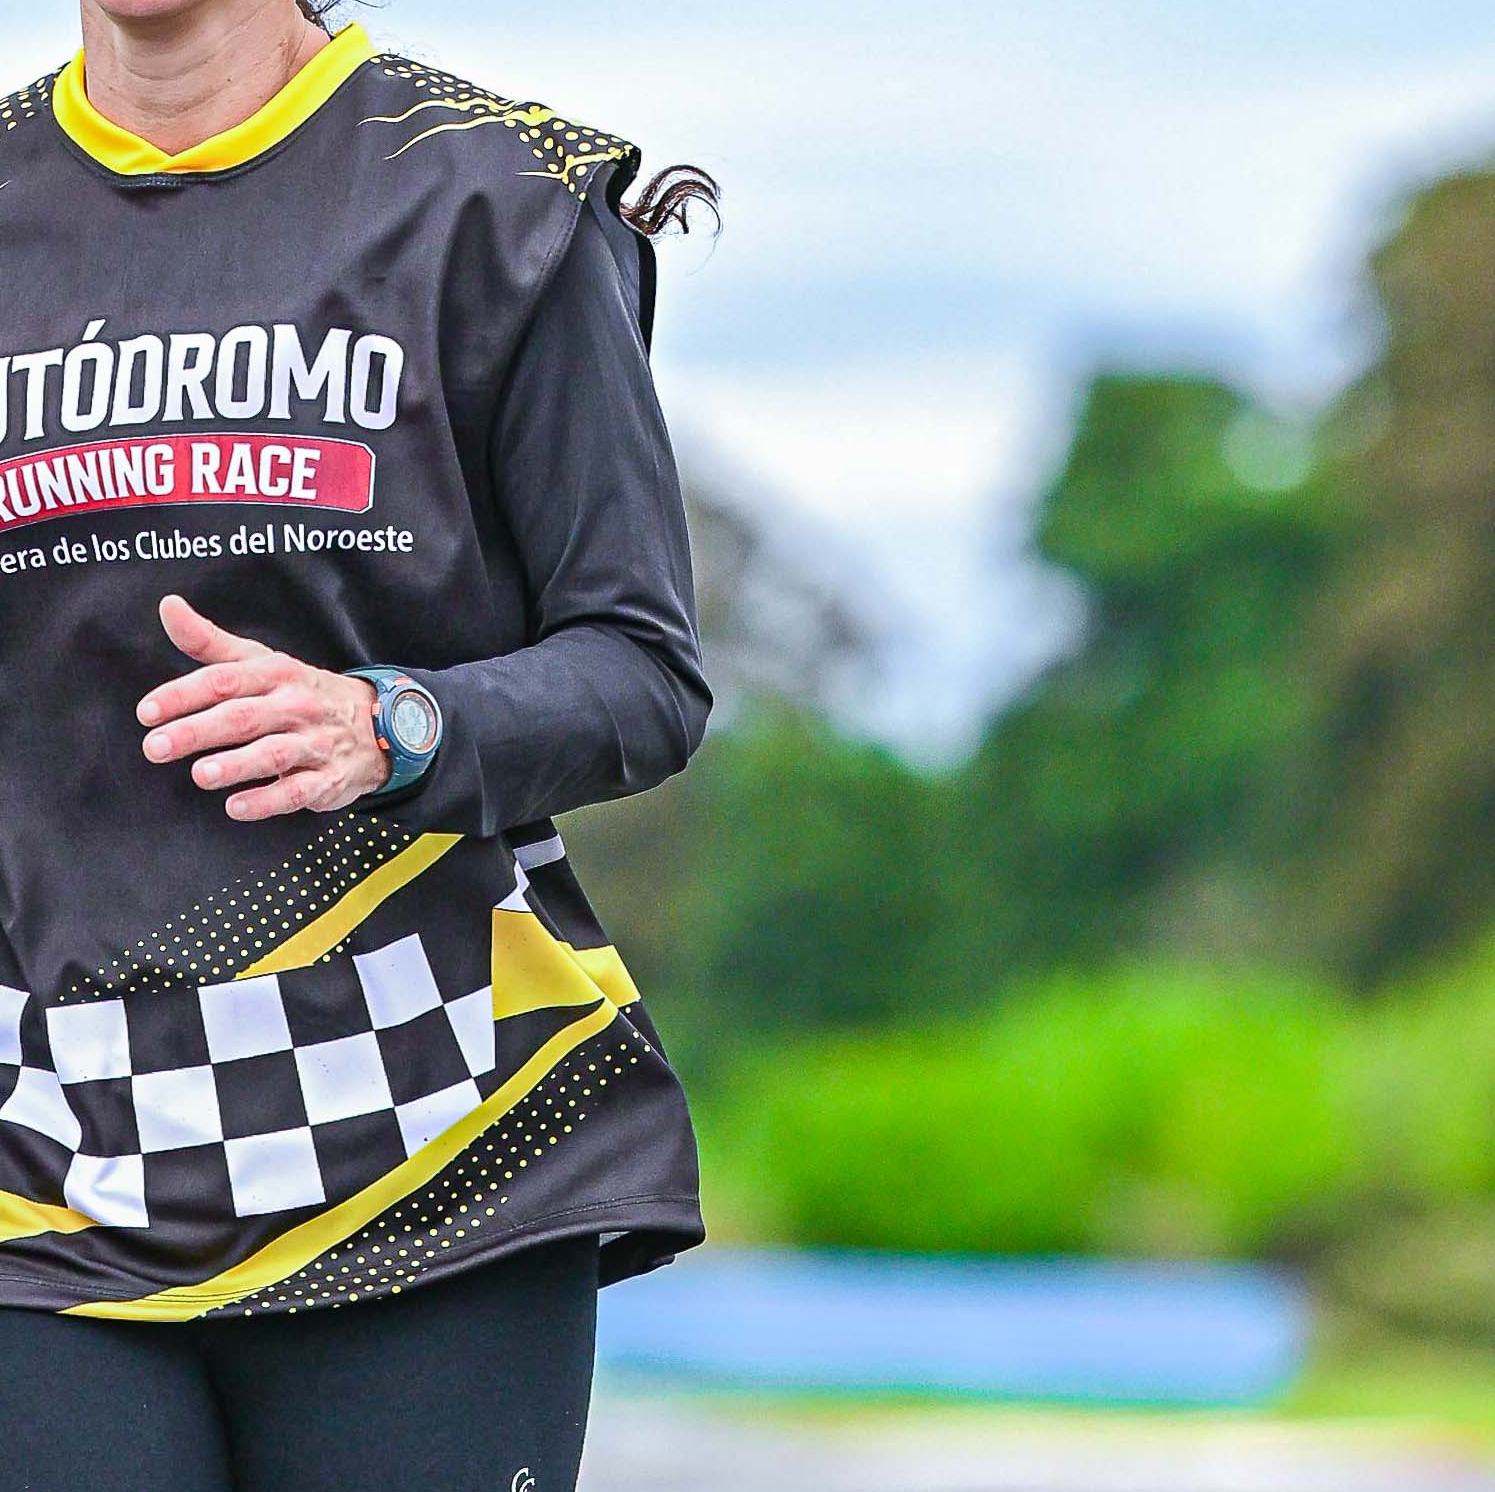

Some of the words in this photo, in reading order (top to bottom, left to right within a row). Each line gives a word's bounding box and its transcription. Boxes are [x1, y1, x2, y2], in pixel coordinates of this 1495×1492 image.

[190, 441, 322, 500] RACE
[52, 536, 88, 565] de
[91, 533, 130, 562] los
[135, 529, 223, 560] Clubes
[229, 523, 275, 555] del
[283, 523, 414, 553] Noroeste
